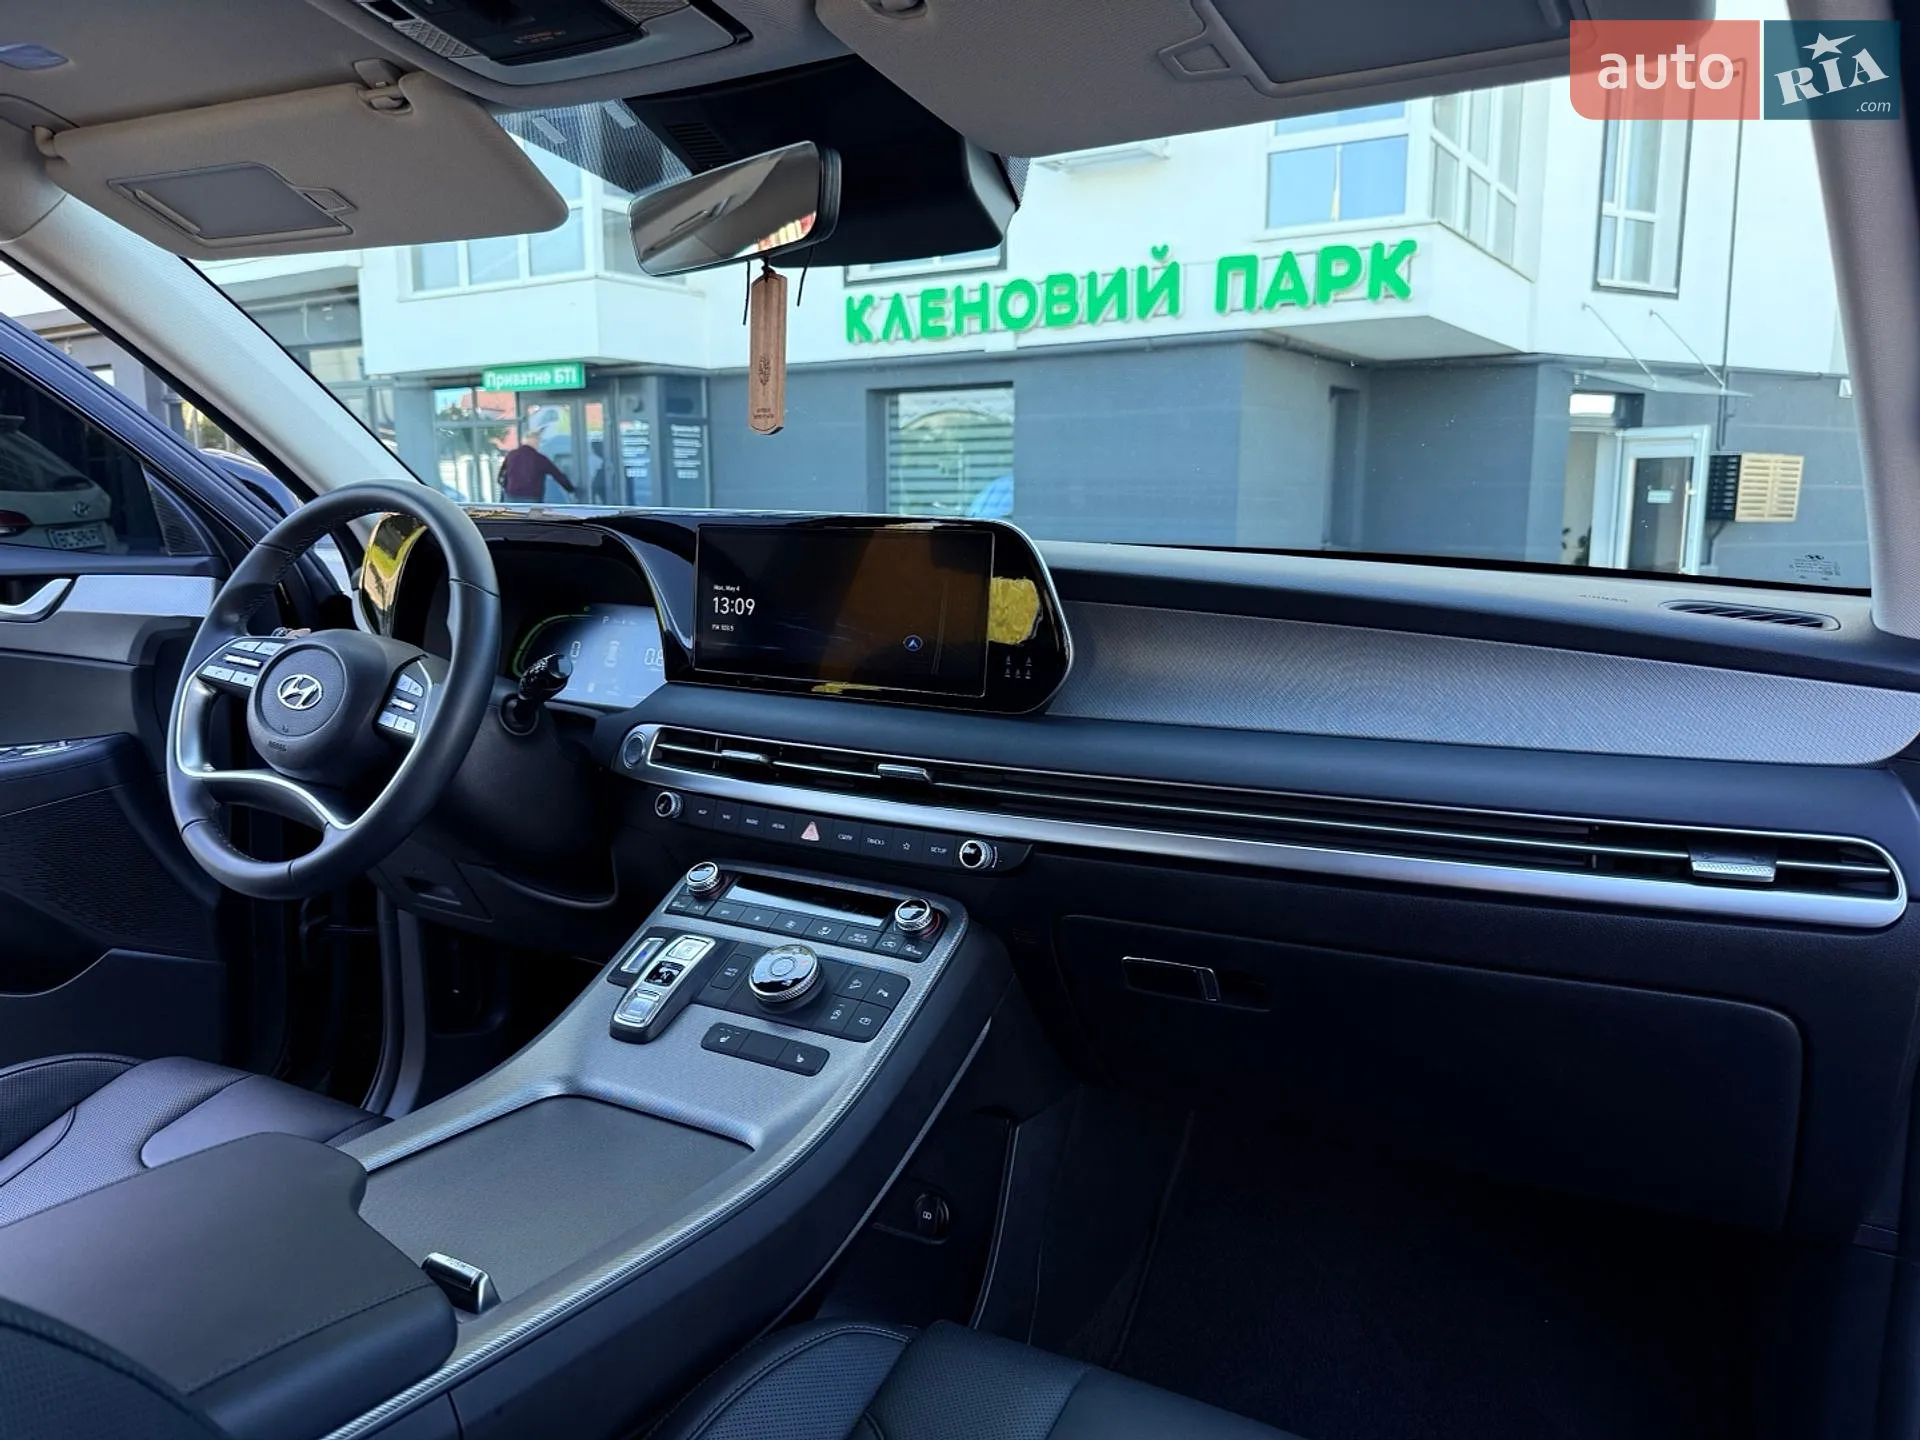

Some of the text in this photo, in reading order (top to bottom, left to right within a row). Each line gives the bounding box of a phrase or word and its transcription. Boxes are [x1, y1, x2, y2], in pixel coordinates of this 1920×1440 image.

[845, 239, 1418, 343] КЛЕНОВИЙ ПАРК
[713, 596, 755, 616] 13:09
